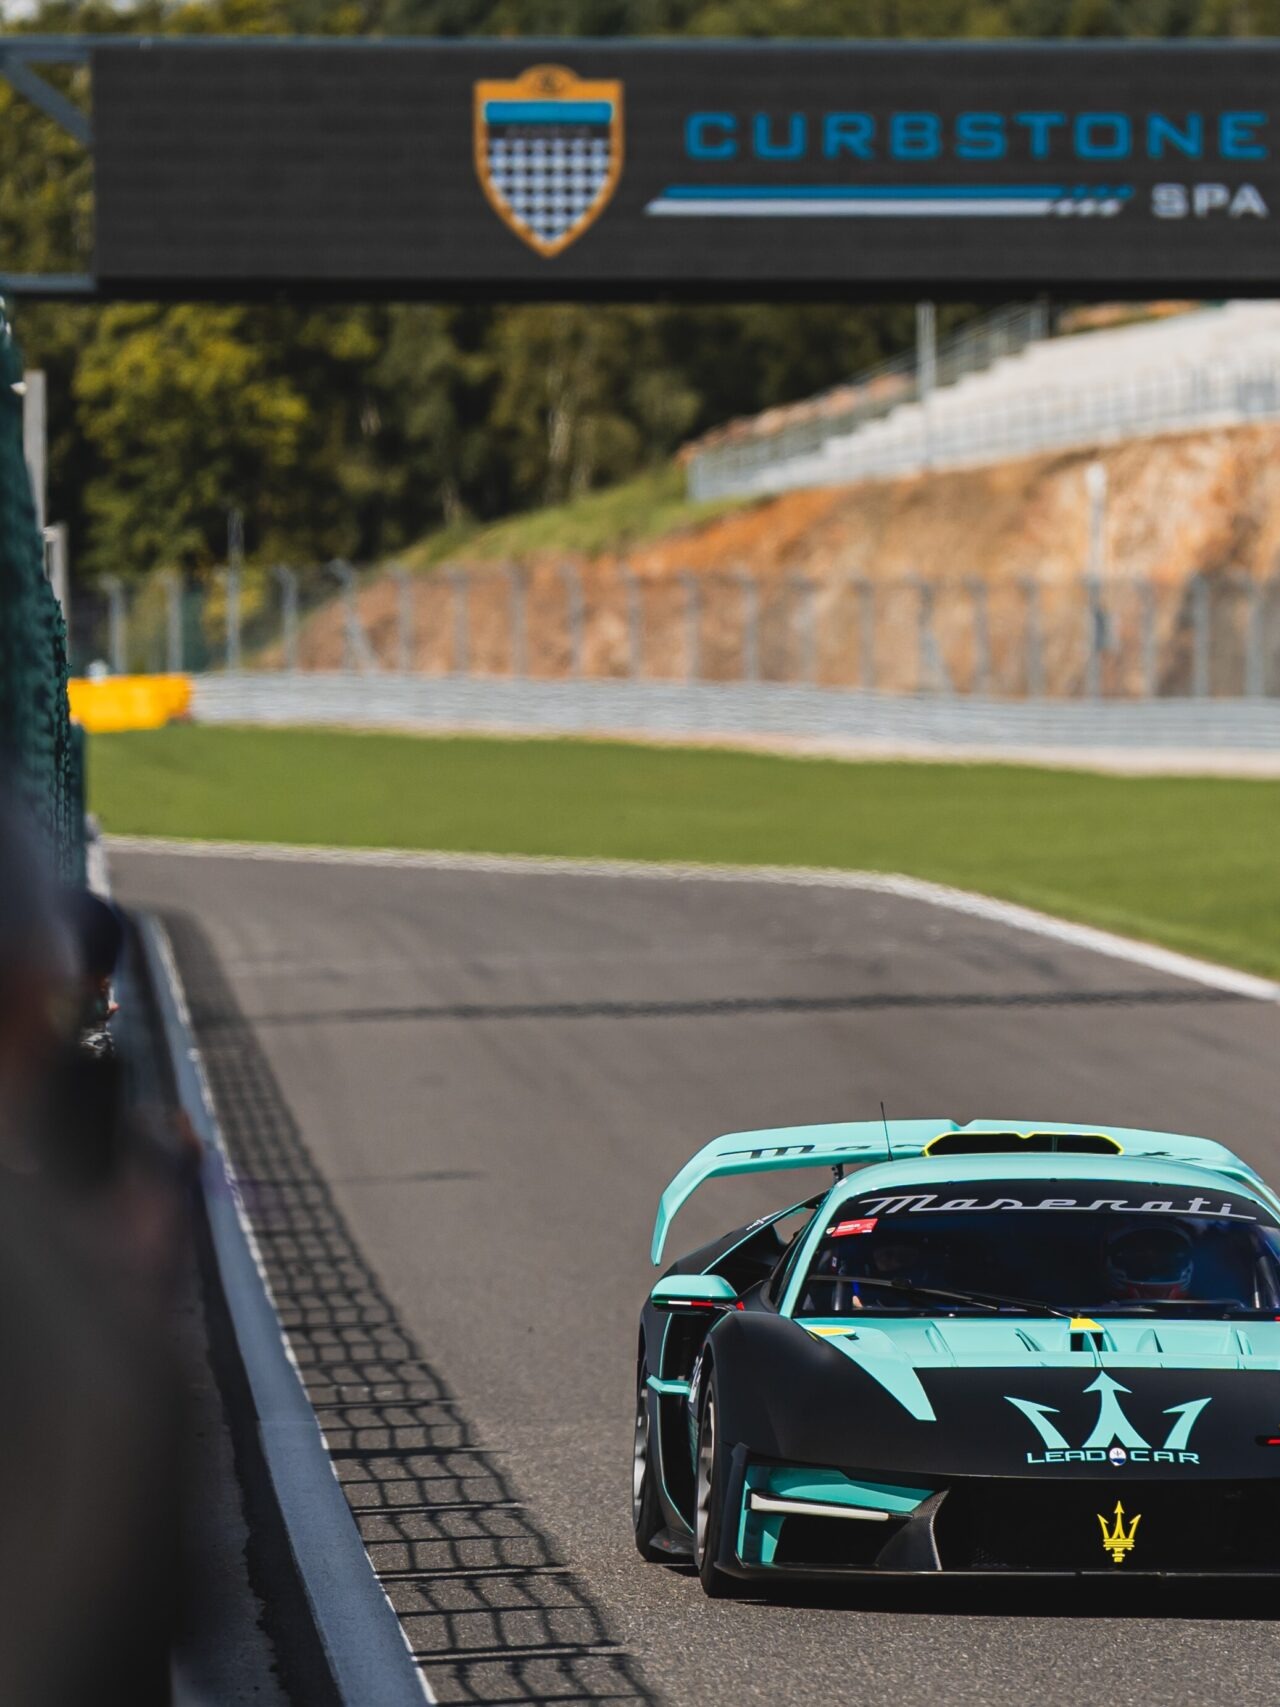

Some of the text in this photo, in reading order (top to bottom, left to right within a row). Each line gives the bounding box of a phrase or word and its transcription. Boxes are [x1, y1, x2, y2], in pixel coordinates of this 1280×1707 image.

[685, 112, 1269, 160] CURBSTONE
[1151, 183, 1269, 218] SPA
[859, 1195, 1257, 1220] Maserati
[1027, 1450, 1200, 1465] LEAD CAR
